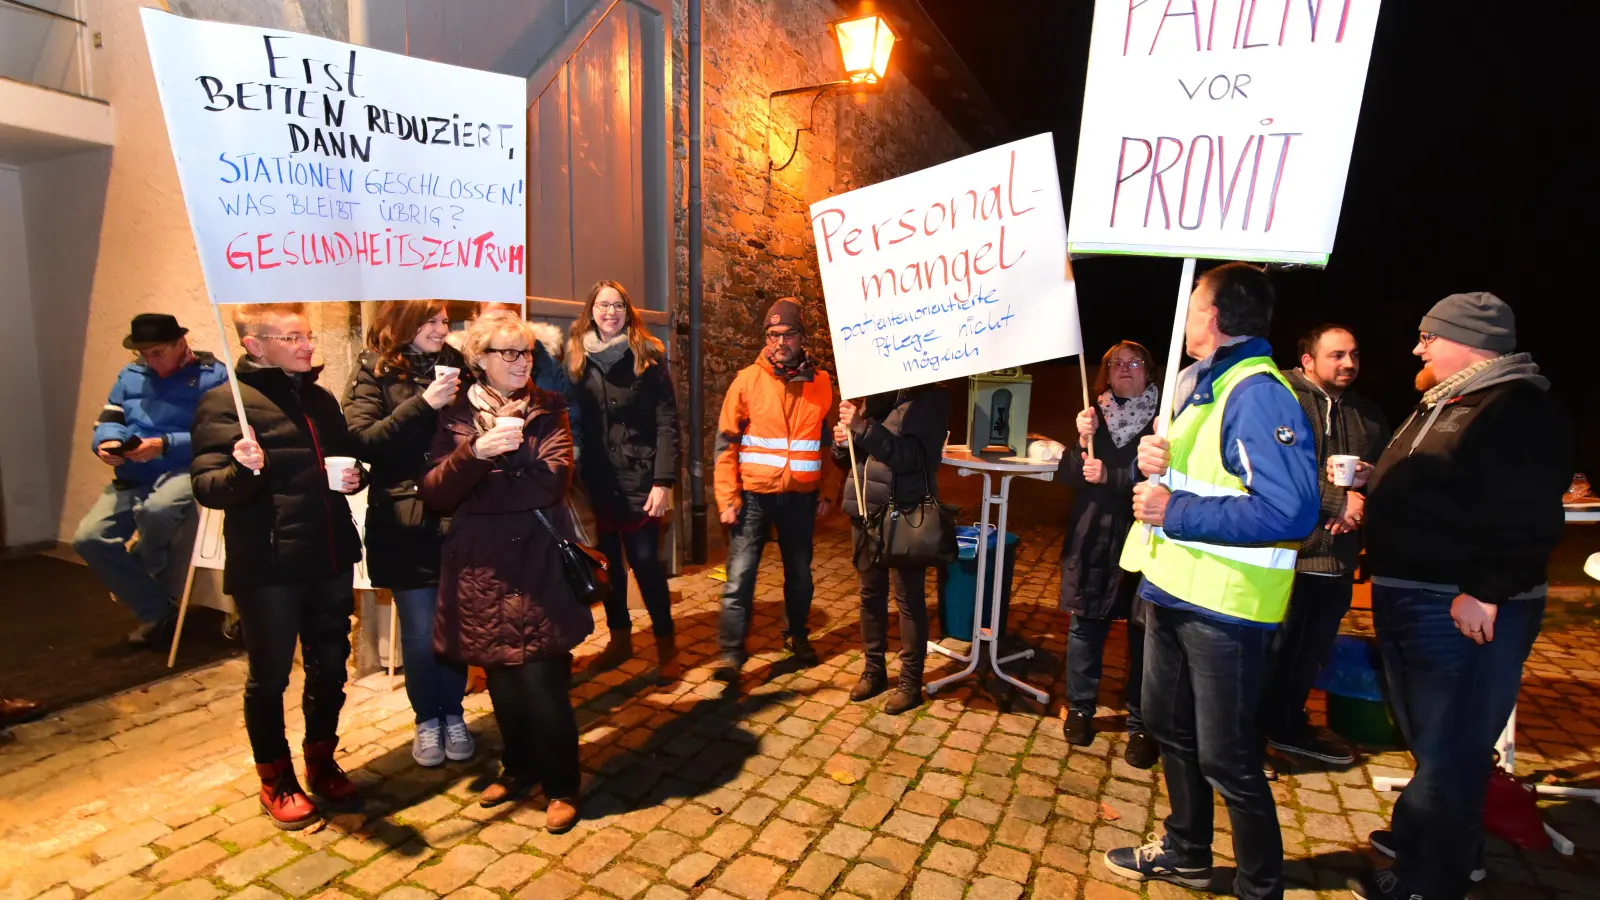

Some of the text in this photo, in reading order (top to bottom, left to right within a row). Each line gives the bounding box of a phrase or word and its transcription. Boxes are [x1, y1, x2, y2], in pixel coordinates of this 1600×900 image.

[262, 34, 366, 99] Erst
[1178, 73, 1252, 101] VOR
[195, 75, 346, 128] BETTEN
[286, 122, 373, 163] DANN
[218, 193, 276, 217] WAS
[364, 168, 524, 208] GESCHLOSSEN!
[861, 225, 1027, 304] mangel
[840, 284, 1000, 349] patientenorientierte
[958, 304, 1016, 338] nicht
